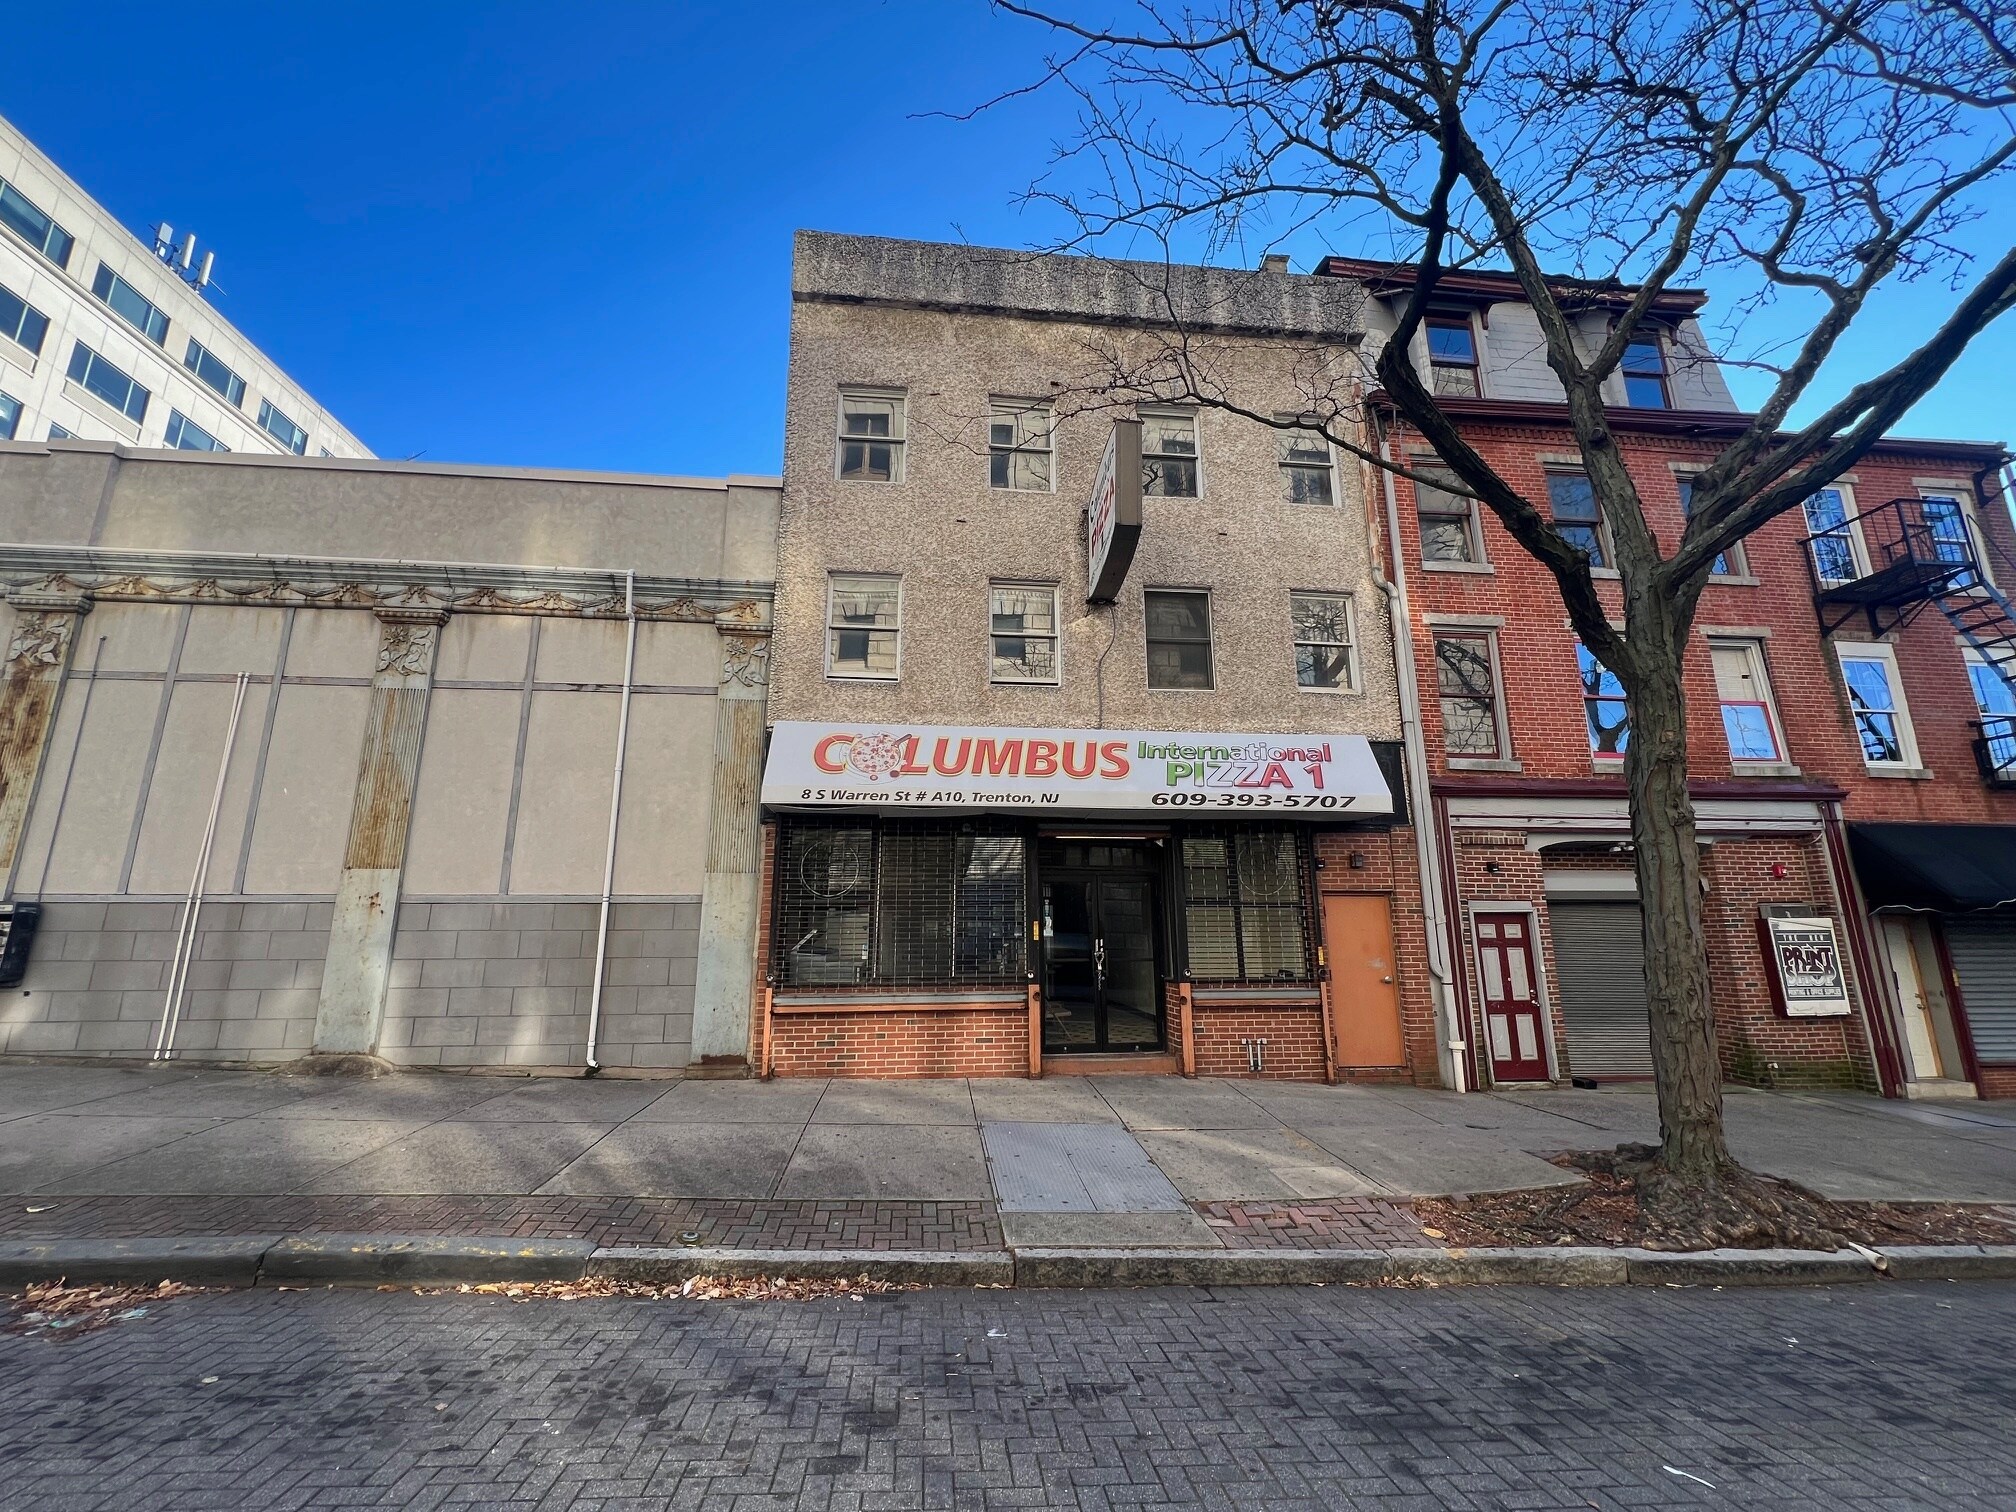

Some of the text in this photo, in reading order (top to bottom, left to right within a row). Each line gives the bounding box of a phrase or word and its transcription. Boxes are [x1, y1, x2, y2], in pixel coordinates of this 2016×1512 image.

[1137, 741, 1332, 763] International
[1167, 761, 1325, 790] PIZZA 1
[801, 789, 1060, 804] 8 S Warren St # A10, Trenton, NJ
[1151, 792, 1357, 809] 609-393-5707
[1780, 944, 1833, 974] PRINT
[1784, 966, 1837, 986] SHOP
